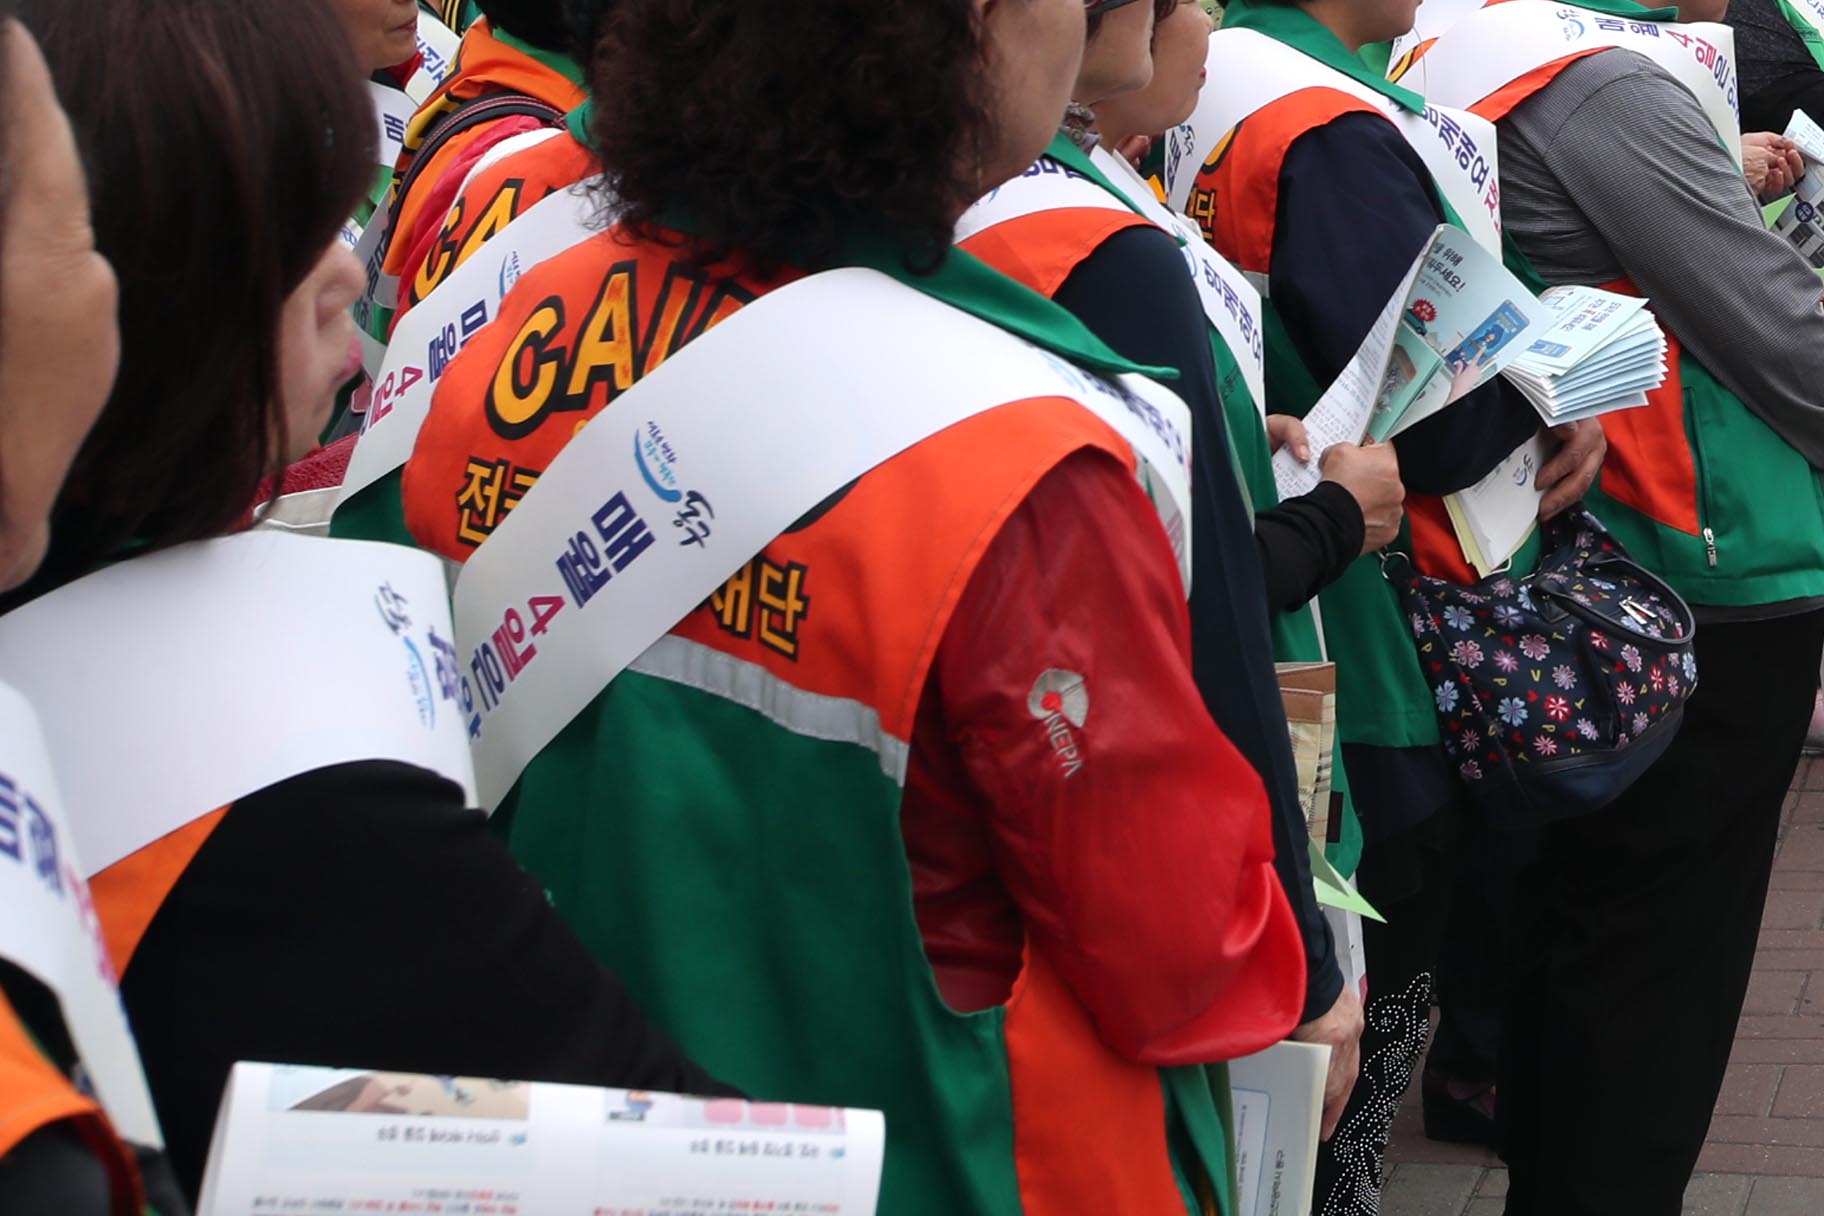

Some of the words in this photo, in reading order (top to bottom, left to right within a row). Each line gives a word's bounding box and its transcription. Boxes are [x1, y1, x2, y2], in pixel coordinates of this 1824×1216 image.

[1594, 17, 1660, 38] 매월
[1664, 28, 1731, 90] 4일은
[361, 364, 424, 436] 4일
[556, 489, 657, 609] 매월
[679, 489, 716, 549] 동구
[471, 594, 566, 716] 4일은
[1043, 711, 1084, 778] NEPA
